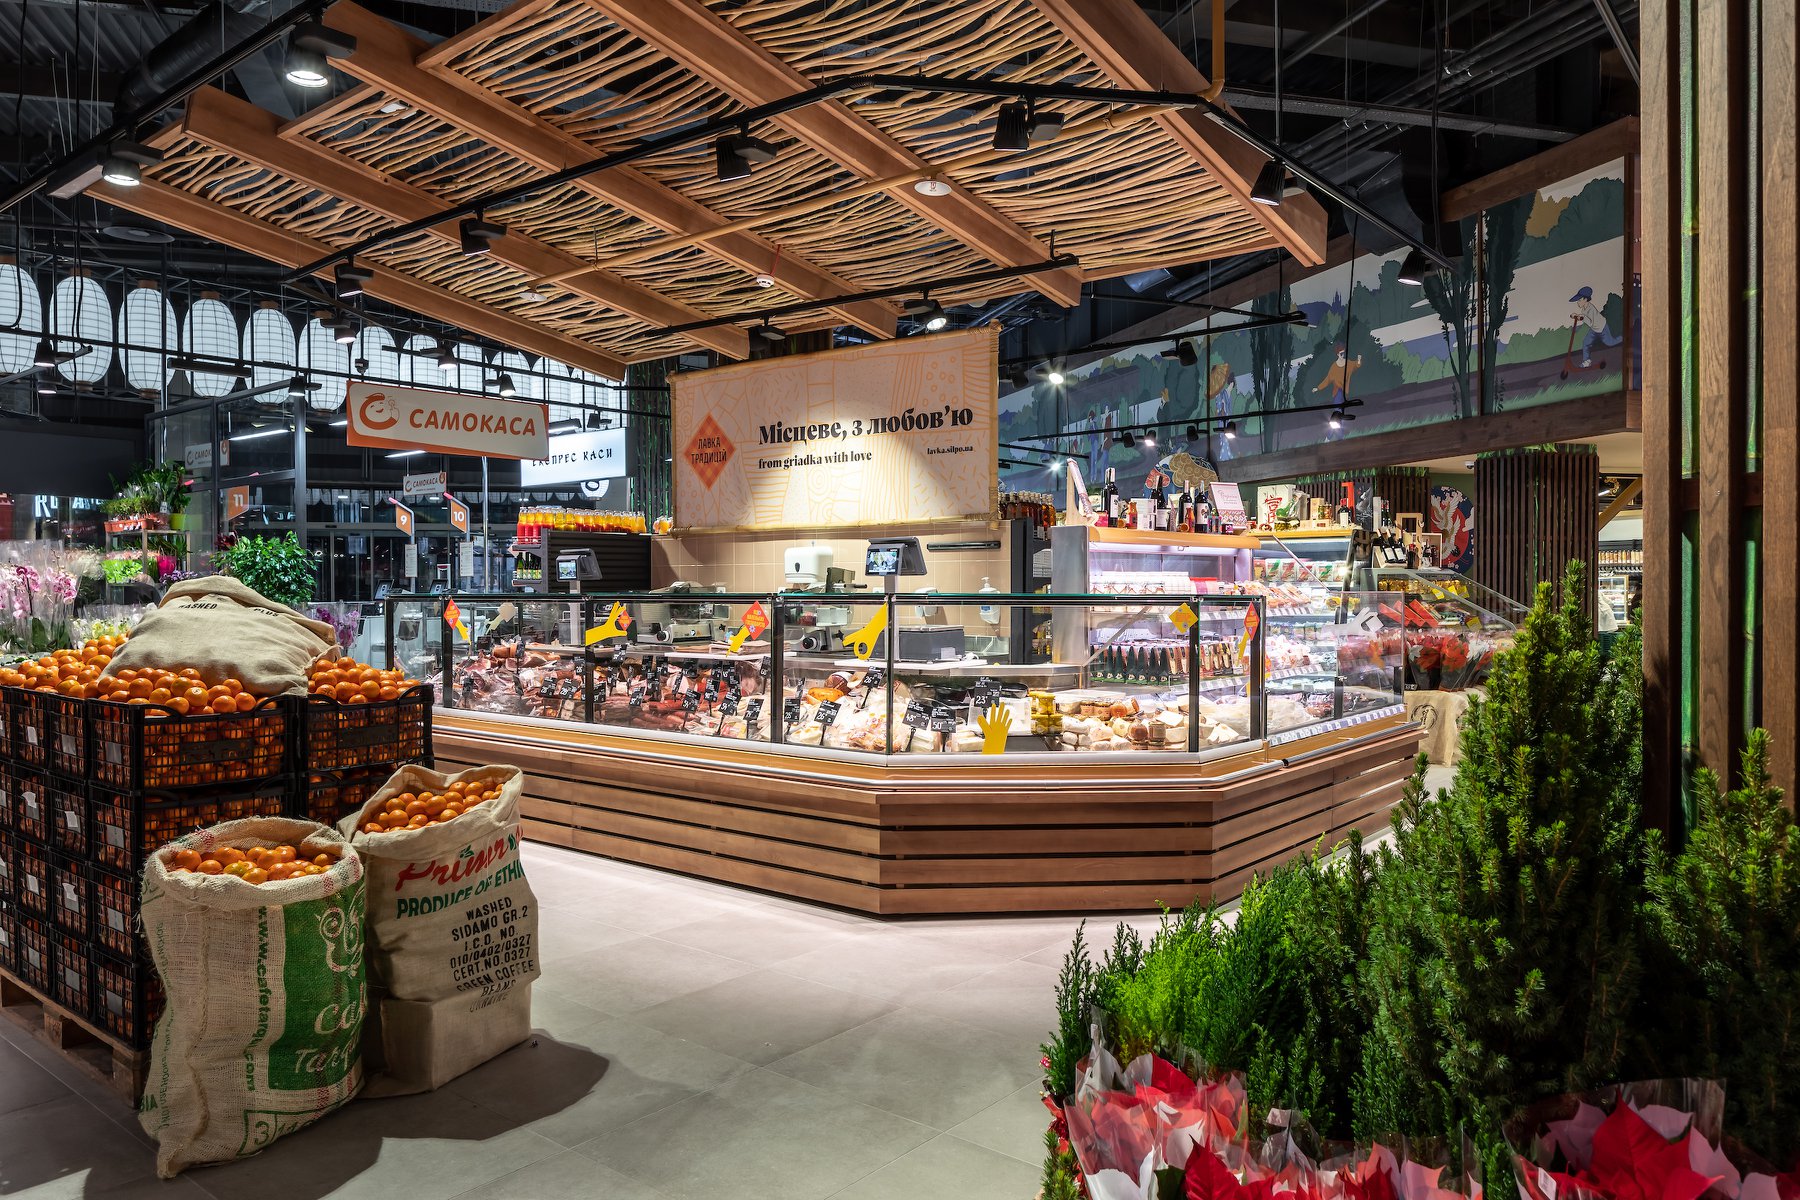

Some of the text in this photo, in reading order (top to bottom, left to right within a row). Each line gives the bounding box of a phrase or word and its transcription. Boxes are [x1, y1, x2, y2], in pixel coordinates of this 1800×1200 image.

[409, 408, 536, 437] САМОКАСА
[759, 421, 847, 446] Місцеве,
[852, 419, 863, 436] з
[698, 436, 721, 450] ЛАВКА
[927, 445, 973, 455] lavka.silpo.ua
[583, 448, 613, 462] КАСИ
[691, 449, 727, 465] ТРАДИЦІЙ
[758, 450, 872, 471] from griadka with love
[233, 494, 244, 507] 11
[400, 514, 408, 526] 9
[453, 511, 465, 522] 10
[396, 886, 473, 919] PRODUCE
[466, 896, 512, 921] WASHED
[451, 905, 528, 942] SIDAMO GR.2
[450, 934, 531, 969] 010/0402/0327
[453, 946, 531, 981] CERT.NO.0327
[456, 960, 534, 993] GREEN COFFEE
